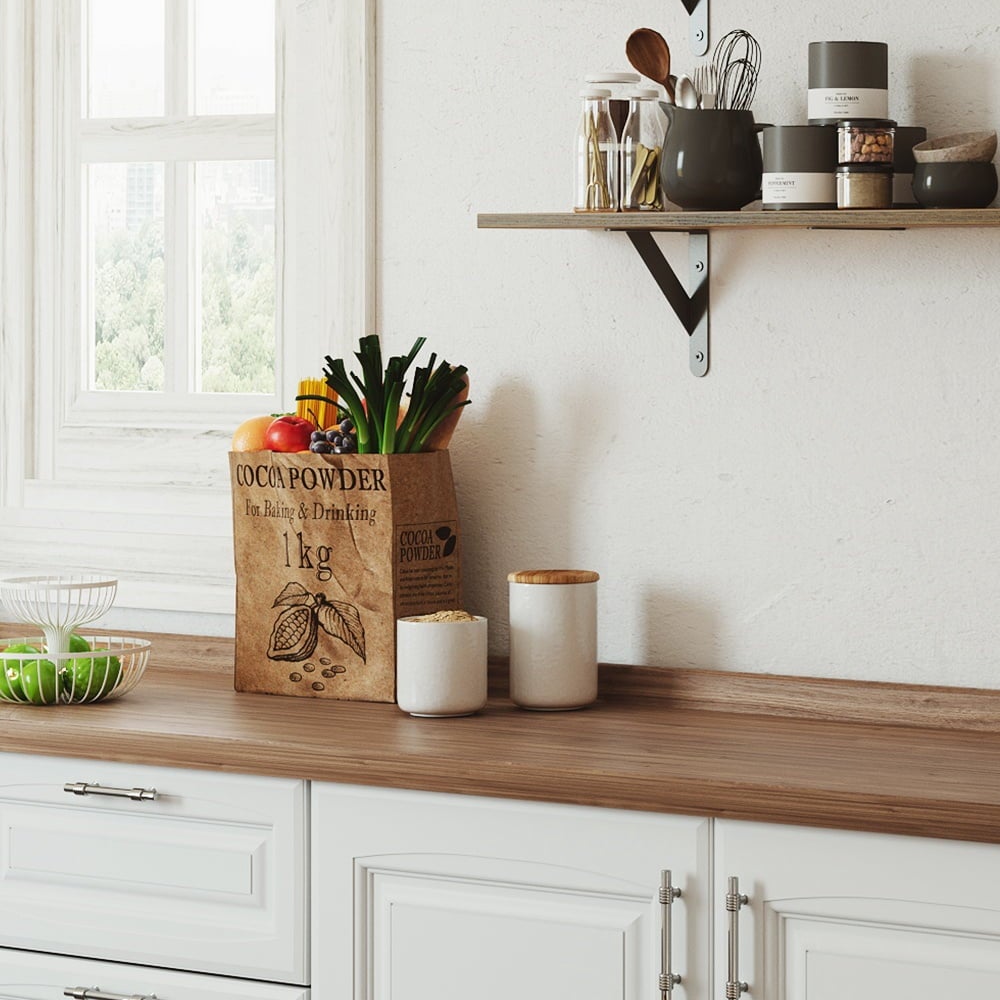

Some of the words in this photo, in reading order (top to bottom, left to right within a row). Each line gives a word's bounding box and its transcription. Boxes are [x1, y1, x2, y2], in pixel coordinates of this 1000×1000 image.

[236, 464, 285, 488] COCOA
[289, 467, 387, 491] POWDER
[245, 499, 260, 517] For
[264, 500, 296, 525] Baking
[297, 502, 308, 520] &
[312, 502, 377, 526] Drinking
[400, 529, 433, 546] COCOA
[400, 545, 441, 563] POWDER
